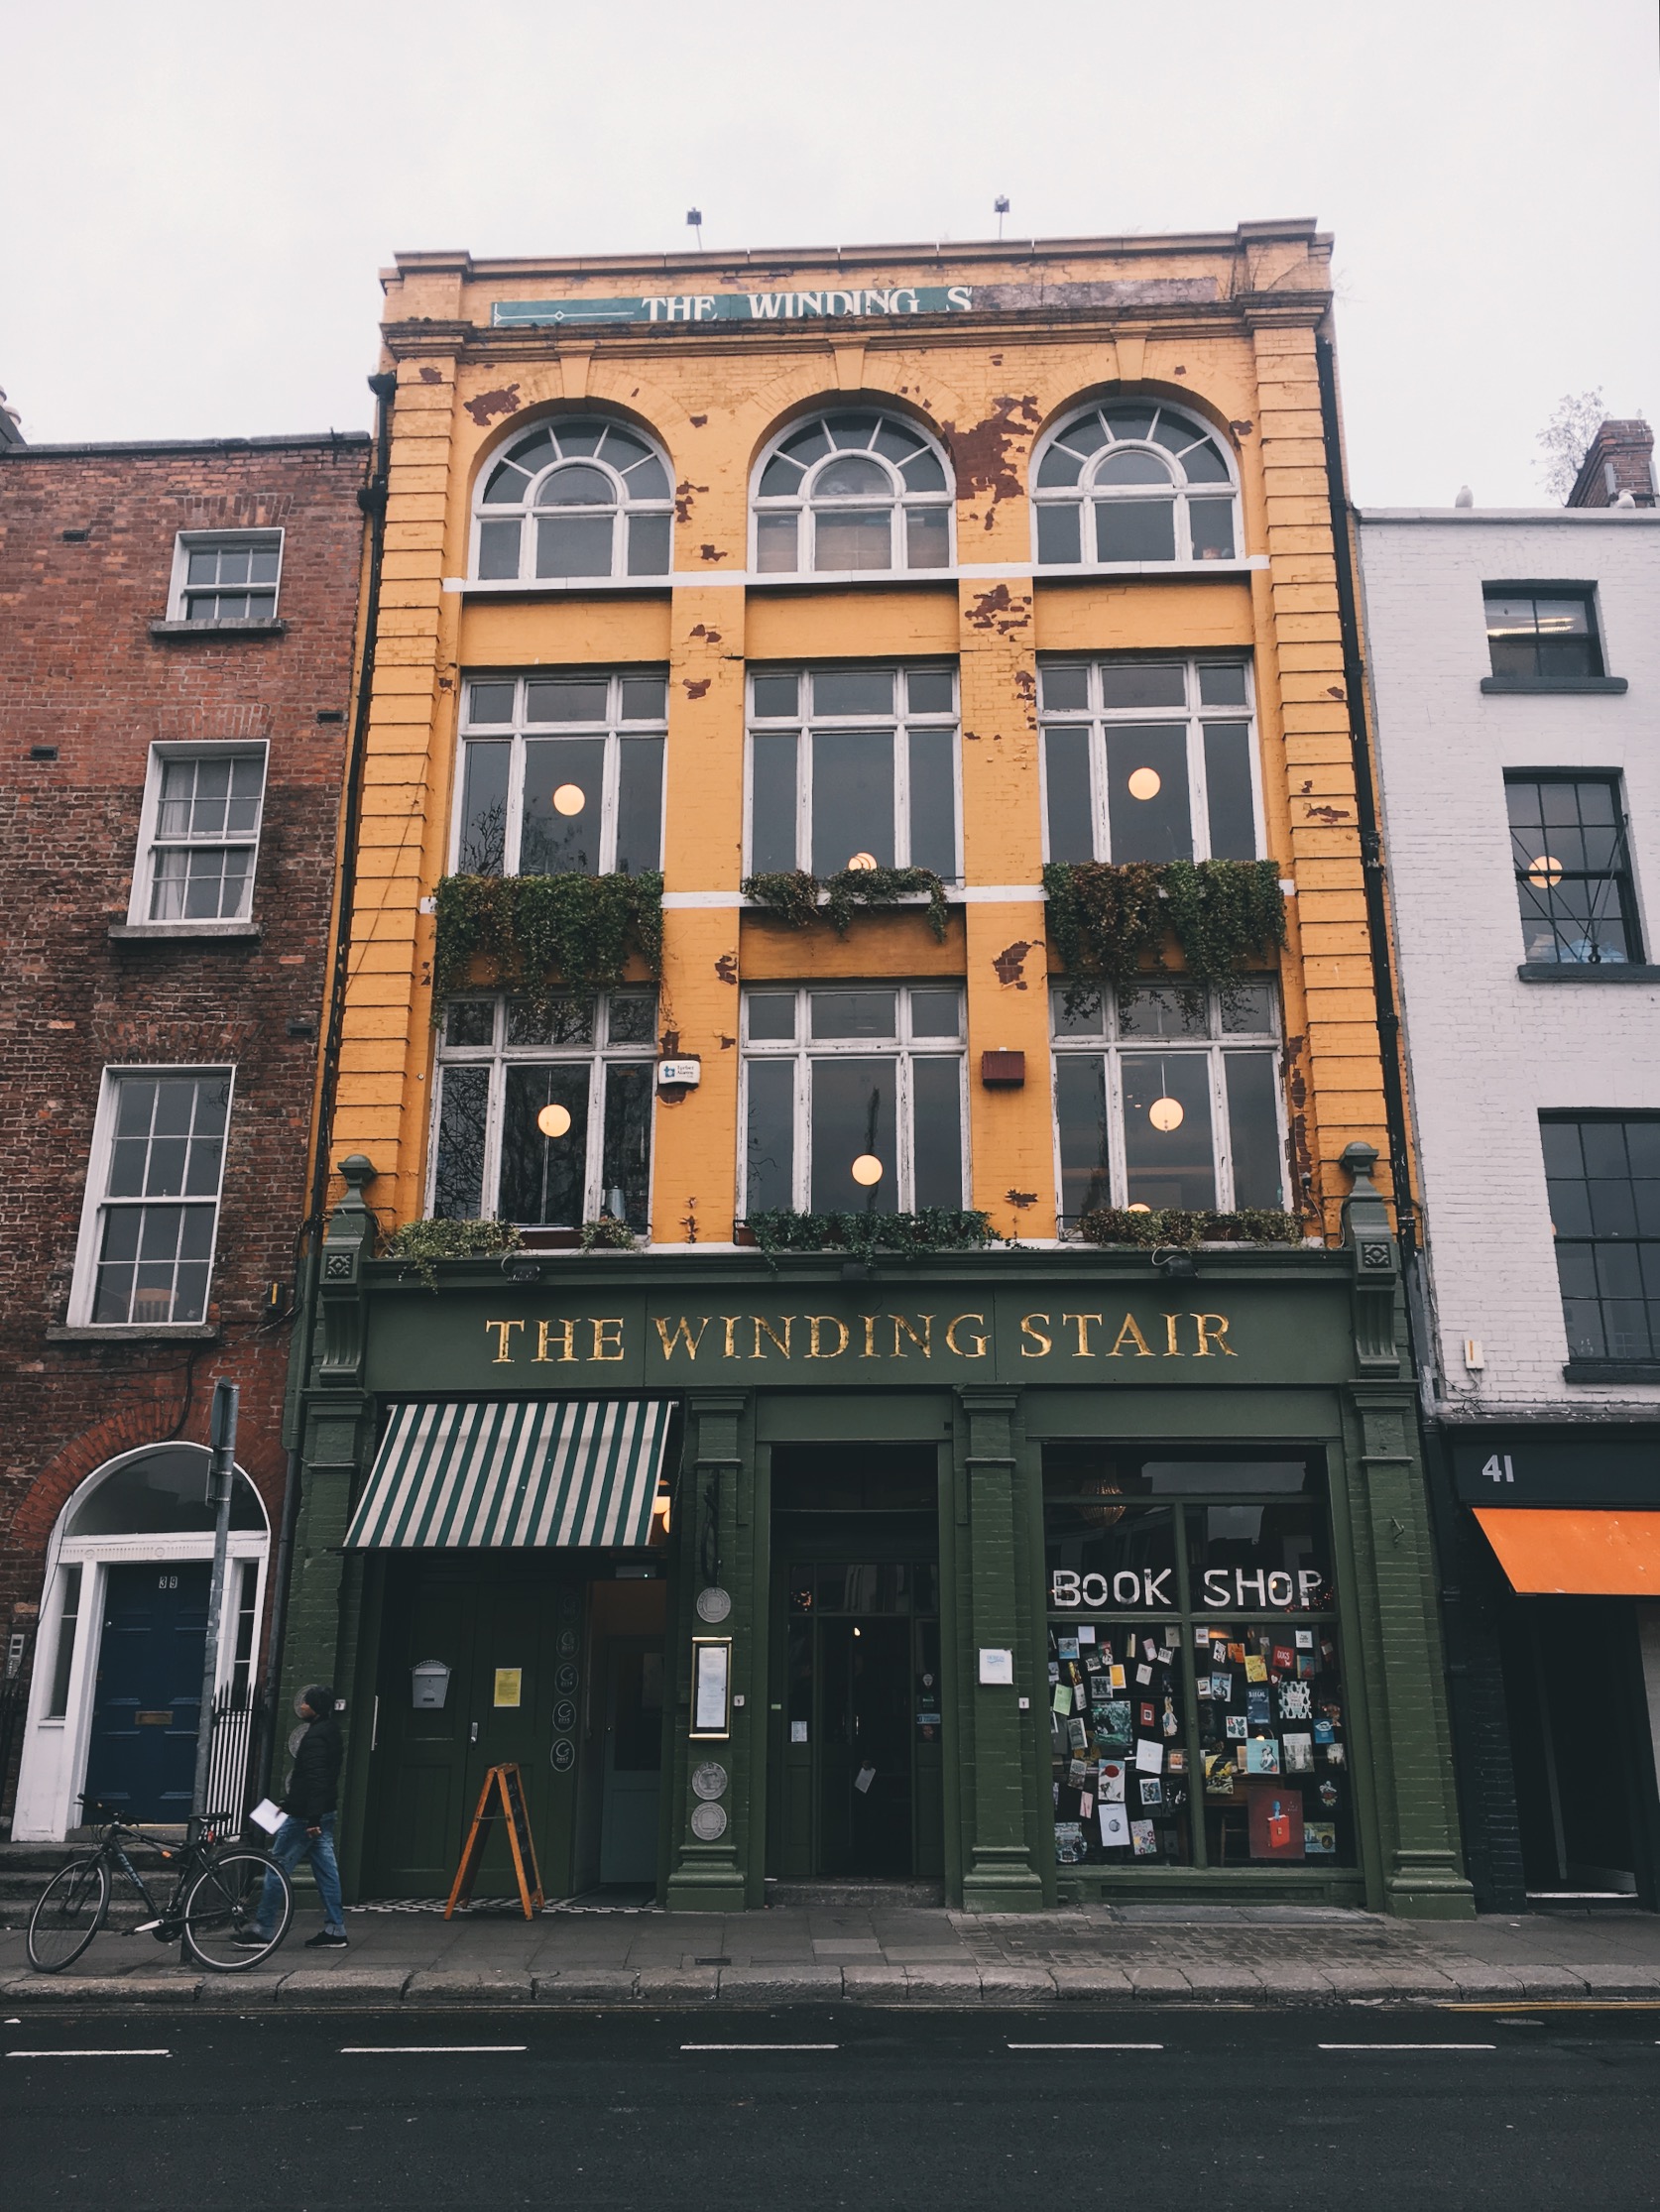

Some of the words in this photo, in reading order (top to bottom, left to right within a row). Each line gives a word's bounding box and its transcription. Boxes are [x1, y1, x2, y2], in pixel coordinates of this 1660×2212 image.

[641, 295, 718, 321] THE
[747, 290, 919, 318] WINDING
[946, 287, 973, 312] S
[485, 1318, 625, 1363] THE
[650, 1314, 992, 1360] WINDING
[1019, 1312, 1240, 1358] STAIR
[1482, 1455, 1514, 1482] 41
[1052, 1568, 1172, 1607] BOOK
[1203, 1568, 1323, 1607] SHOP
